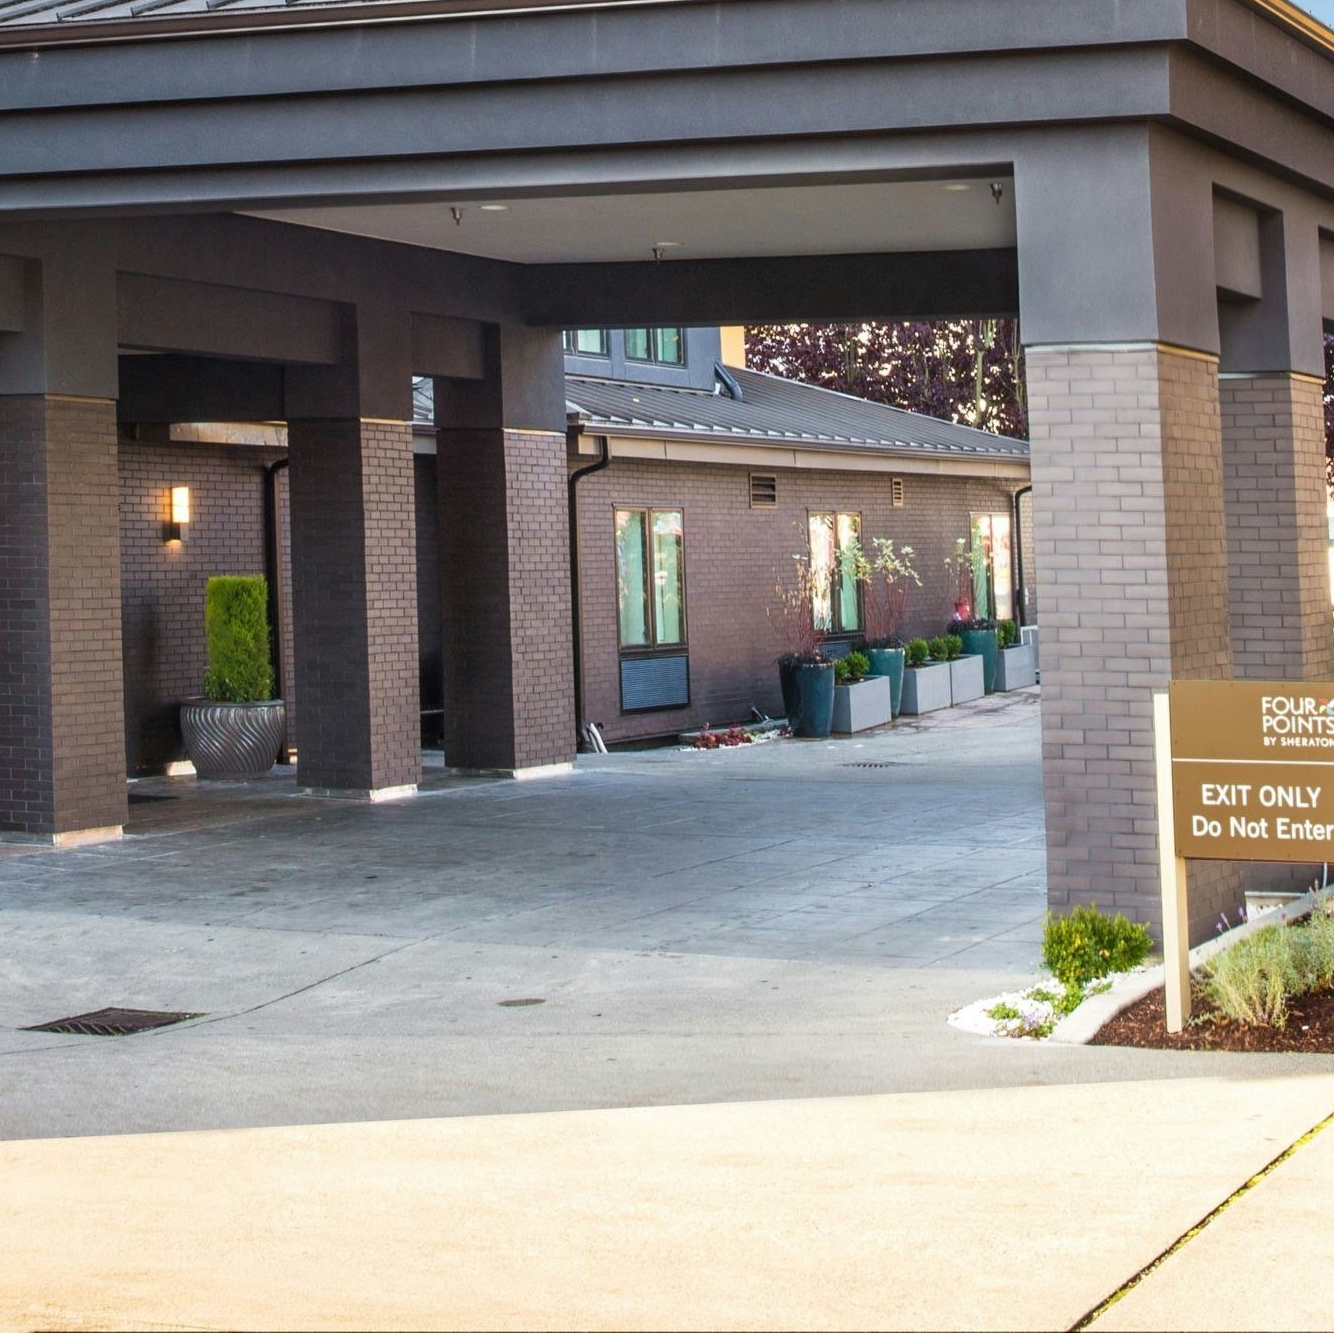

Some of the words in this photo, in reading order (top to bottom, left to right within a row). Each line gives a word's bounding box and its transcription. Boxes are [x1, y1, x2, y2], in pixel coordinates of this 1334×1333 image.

[1262, 697, 1318, 714] FOUR
[1264, 737, 1276, 746] BY
[1202, 784, 1251, 806] EXIT
[1259, 786, 1321, 808] ONLY
[1192, 815, 1222, 837] Do
[1230, 817, 1268, 838] Not
[1277, 818, 1334, 840] Enter
